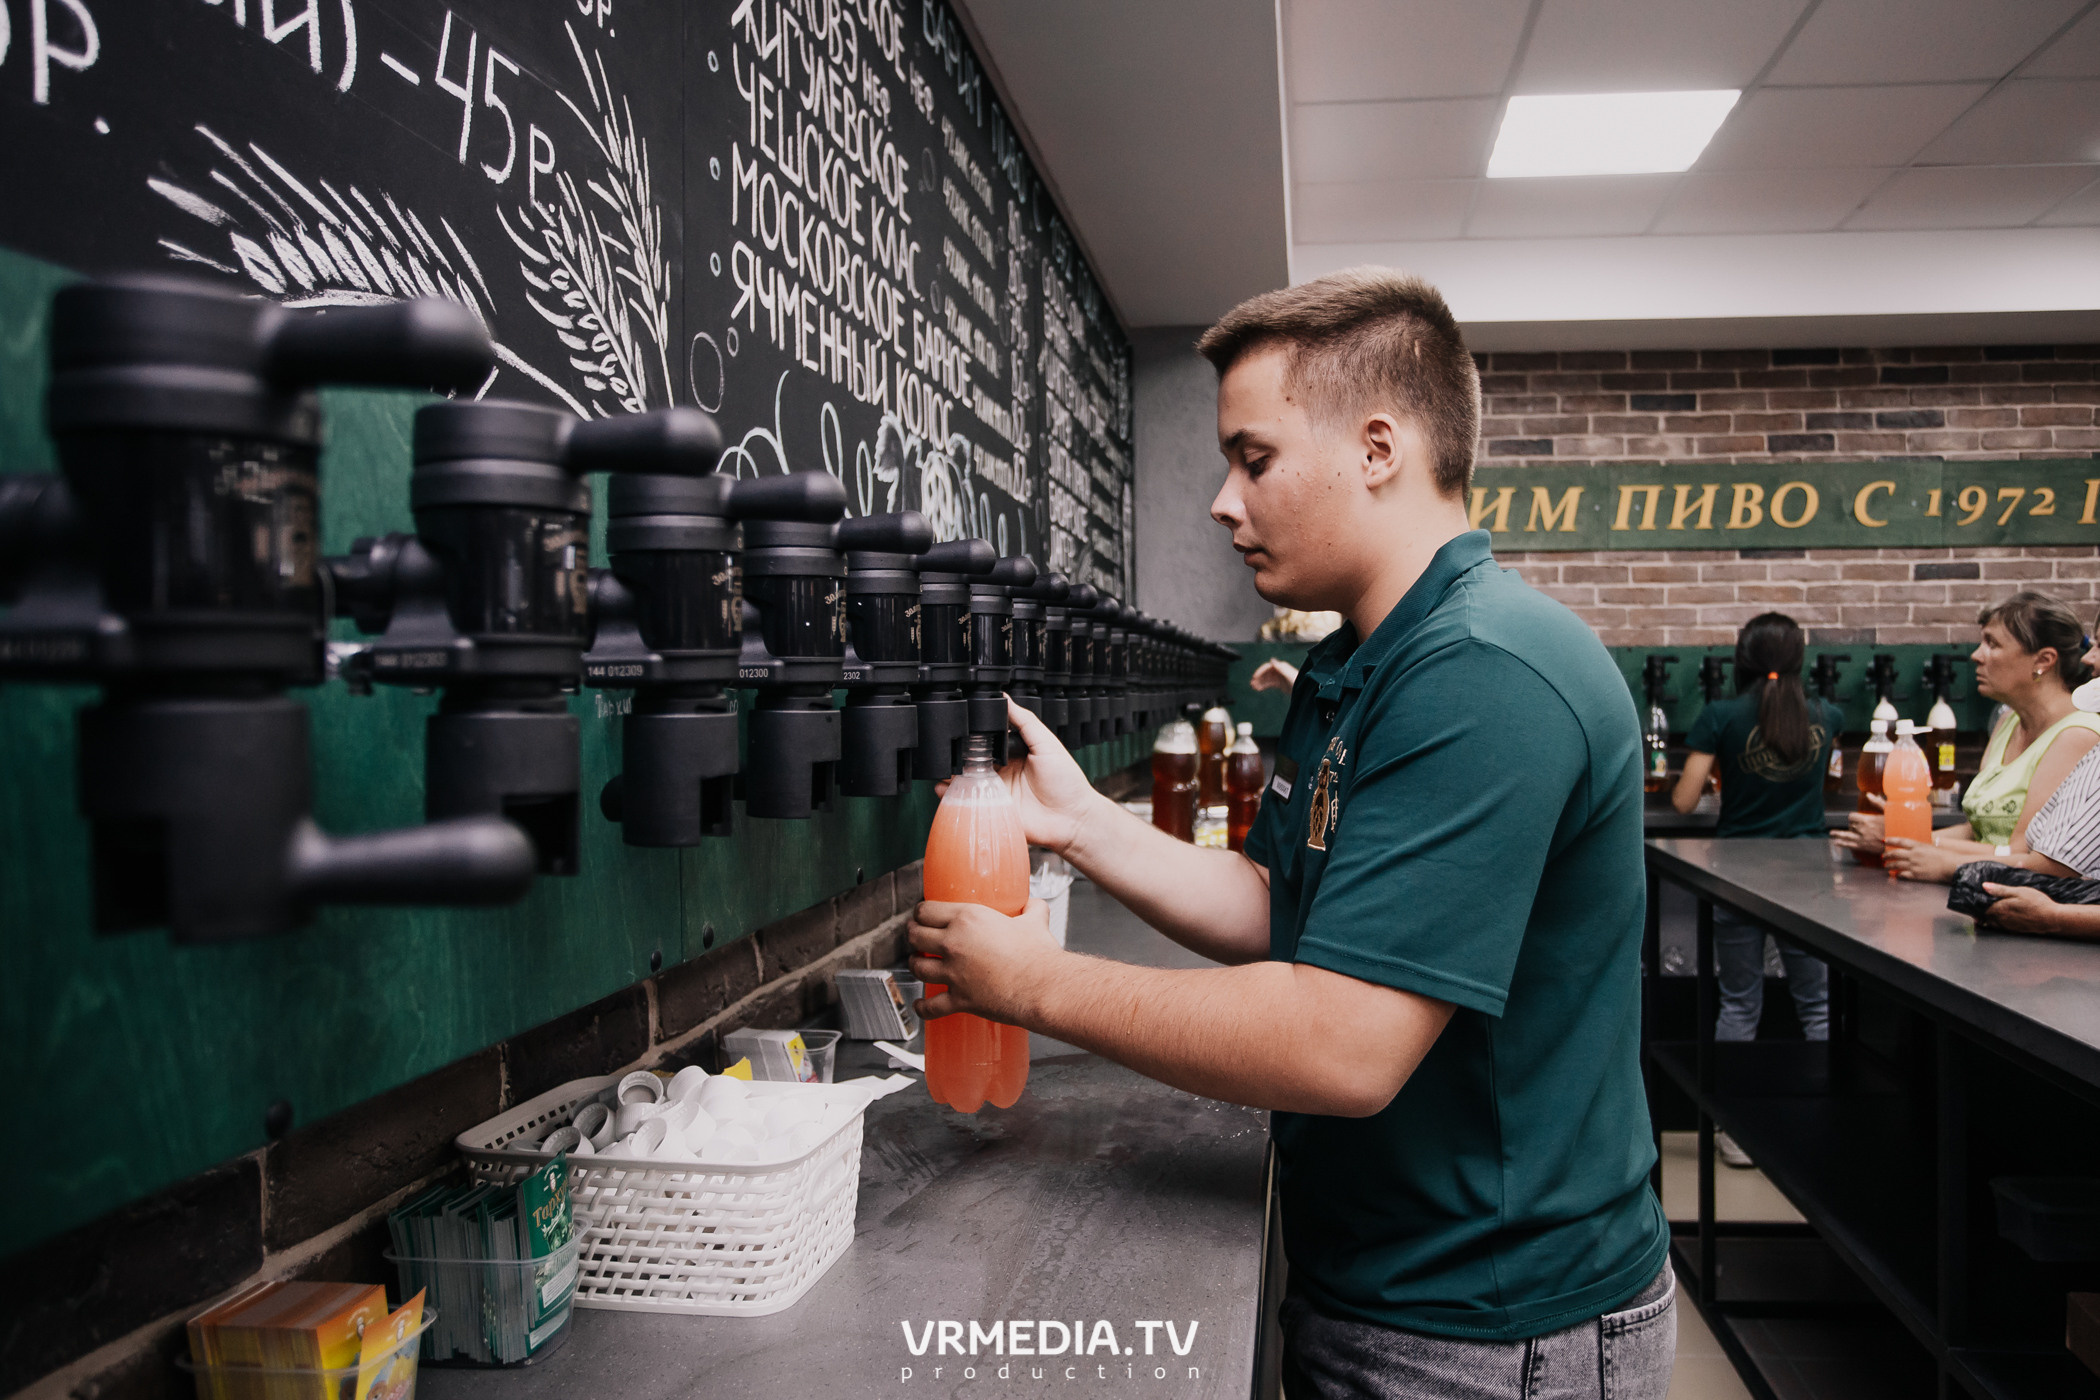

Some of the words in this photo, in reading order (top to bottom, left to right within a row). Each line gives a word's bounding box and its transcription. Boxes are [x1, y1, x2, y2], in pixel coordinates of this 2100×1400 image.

[732, 41, 867, 247] ЧЕШСКОЕ
[732, 140, 908, 360] МОСКОВСКОЕ
[913, 307, 974, 409] БАРНОЕ
[730, 238, 890, 416] ЯЧМЕННЫЙ
[896, 360, 955, 456] КОЛОС
[1612, 481, 1820, 531] ПИВО
[1852, 480, 1896, 528] С
[1924, 484, 2057, 527] 1972
[588, 665, 605, 677] 144
[739, 668, 769, 679] 012300
